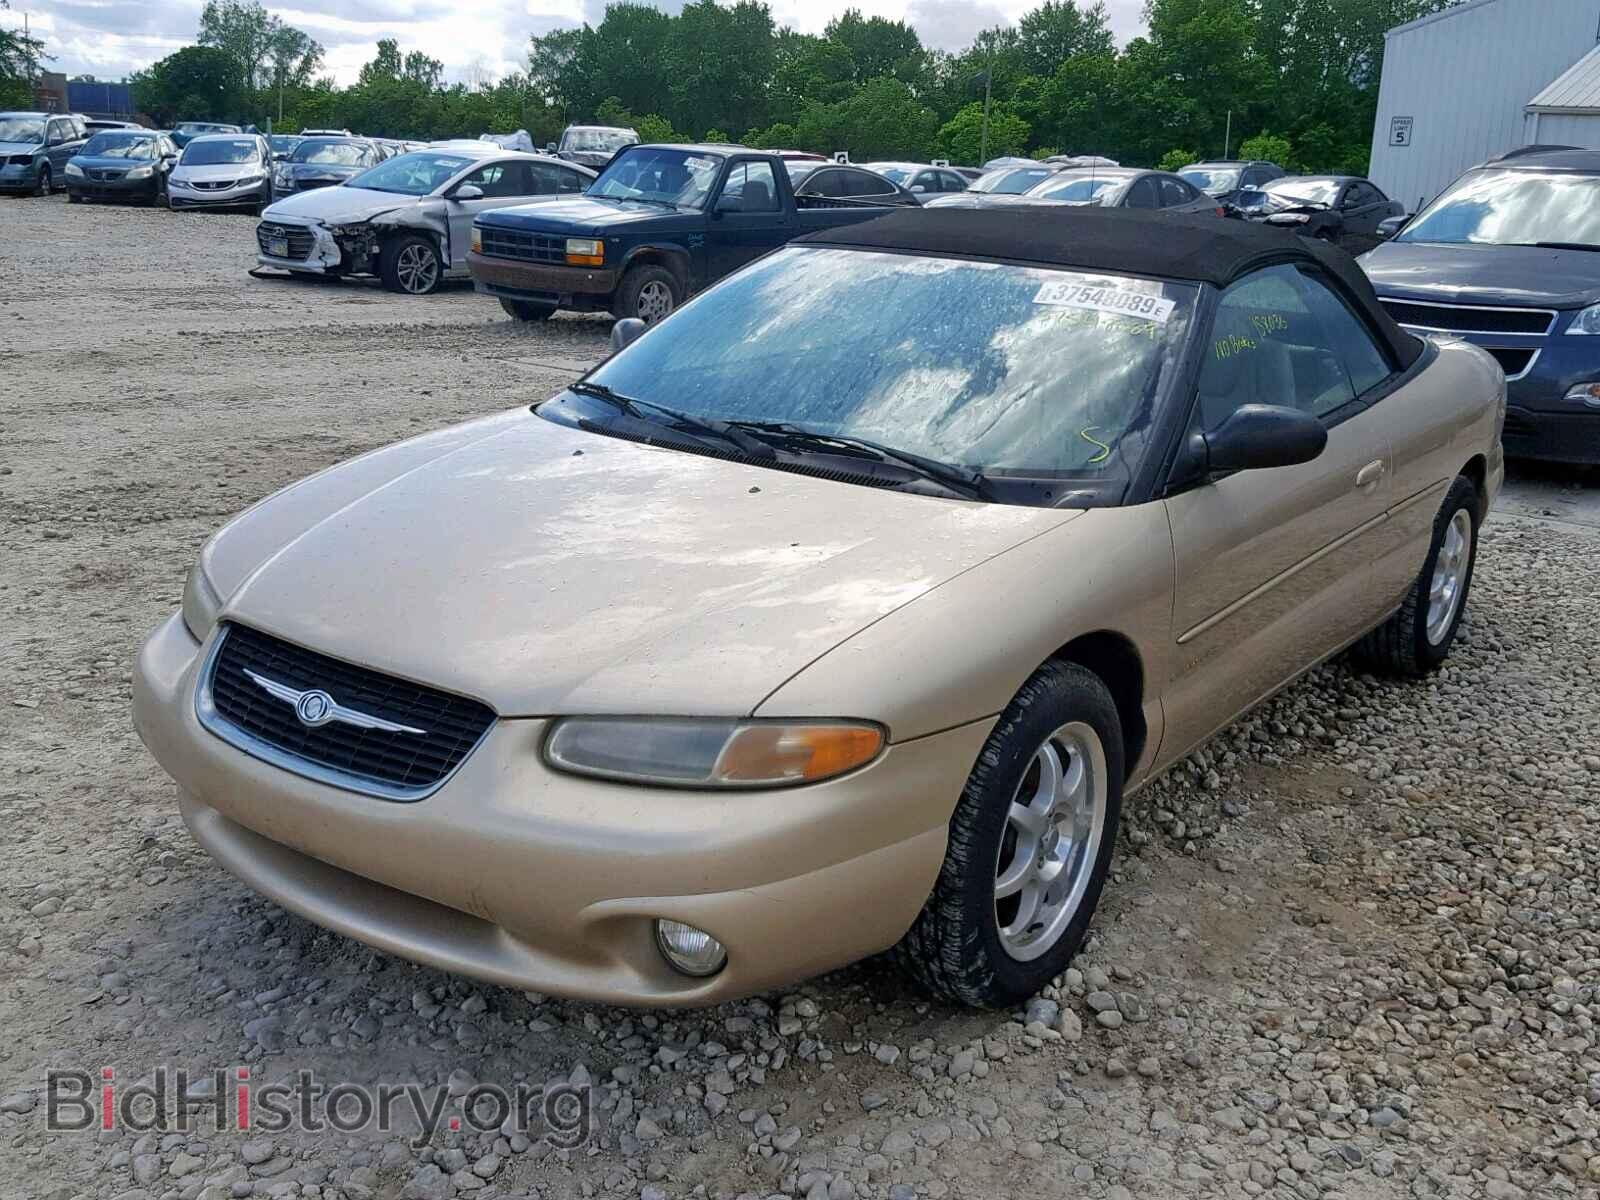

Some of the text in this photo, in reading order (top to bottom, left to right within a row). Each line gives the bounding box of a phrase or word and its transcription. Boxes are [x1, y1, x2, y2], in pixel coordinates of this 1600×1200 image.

[1395, 131, 1404, 143] 5
[1052, 284, 1157, 314] 37548089
[1080, 425, 1110, 463] S
